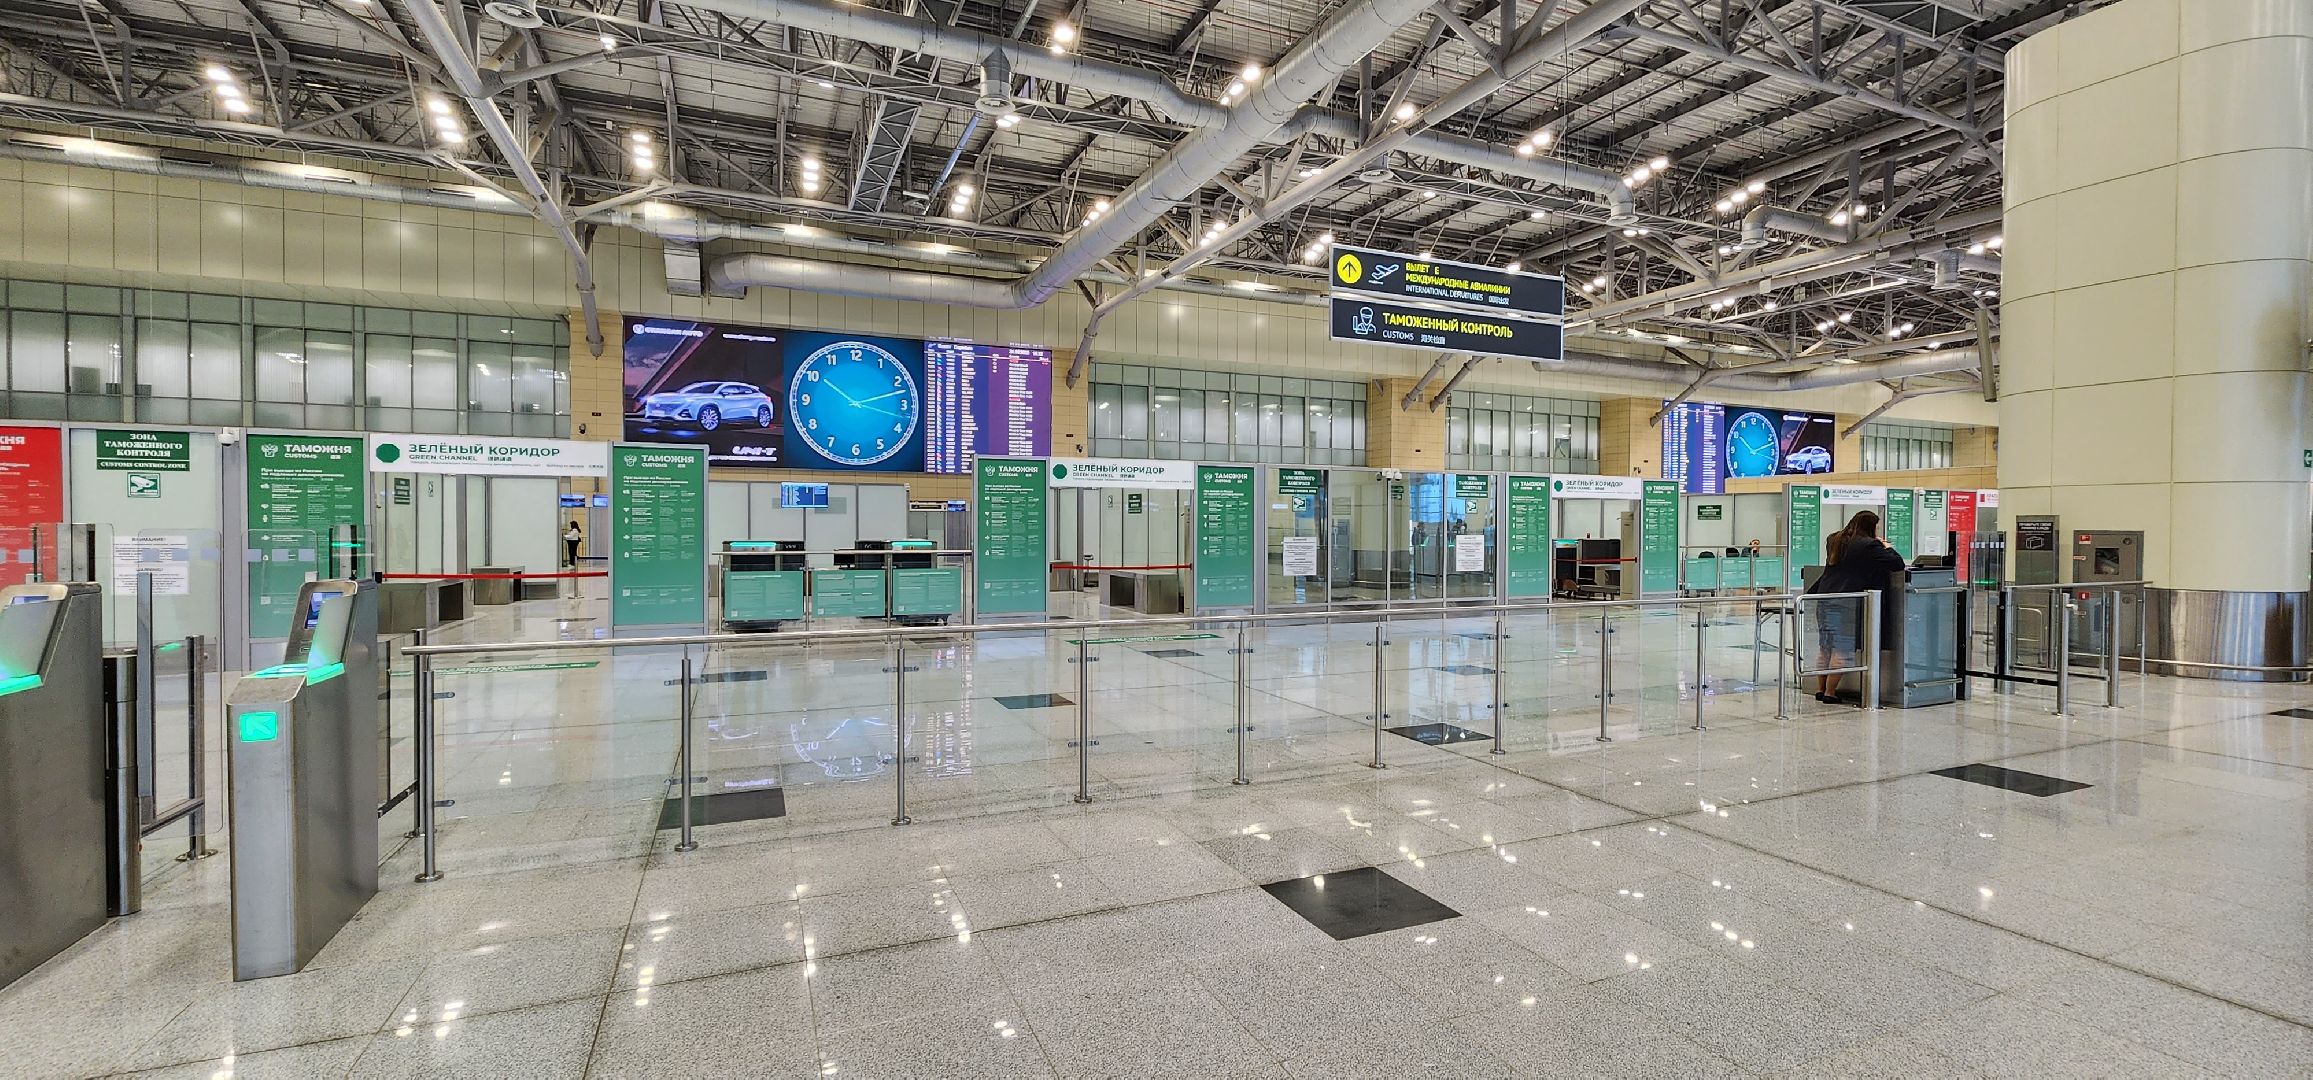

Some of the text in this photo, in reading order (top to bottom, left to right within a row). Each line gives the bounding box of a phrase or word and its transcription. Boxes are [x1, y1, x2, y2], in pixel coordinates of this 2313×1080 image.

[1405, 262, 1430, 273] ВЫЛЕТ
[1405, 273, 1511, 295] МЕЖДУНАРОДНЫЕ АВИАЛИНИИ
[1405, 284, 1484, 301] INTERNATIONAL DEPARTURES
[1382, 312, 1513, 338] ТАМОЖЕННЫЙ КОНТРОЛЬ
[1382, 330, 1415, 341] CUSTOMS
[826, 354, 837, 366] 11
[850, 349, 862, 361] 12
[877, 358, 884, 369] 1
[806, 370, 820, 383] 10
[893, 375, 903, 388] 2
[801, 393, 811, 406] 9
[900, 399, 908, 411] 3
[808, 418, 818, 431] 8
[893, 422, 903, 434] 4
[130, 433, 157, 441] ЗОНА
[827, 436, 836, 448] 7
[1768, 434, 1773, 442] 2
[104, 441, 183, 450] ТАМОЖЕННОГО
[284, 444, 352, 454] ТАМОЖНЯ
[409, 442, 560, 458] ЗЕЛЁНЫЙ КОРИДОР
[851, 443, 861, 456] 6
[876, 438, 885, 450] 5
[116, 449, 171, 458] КОНТРОЛЯ
[641, 454, 695, 464] ТАМОЖНЯ
[998, 465, 1038, 473] ТАМОЖНЯ
[1120, 466, 1165, 475] КОРИДОР
